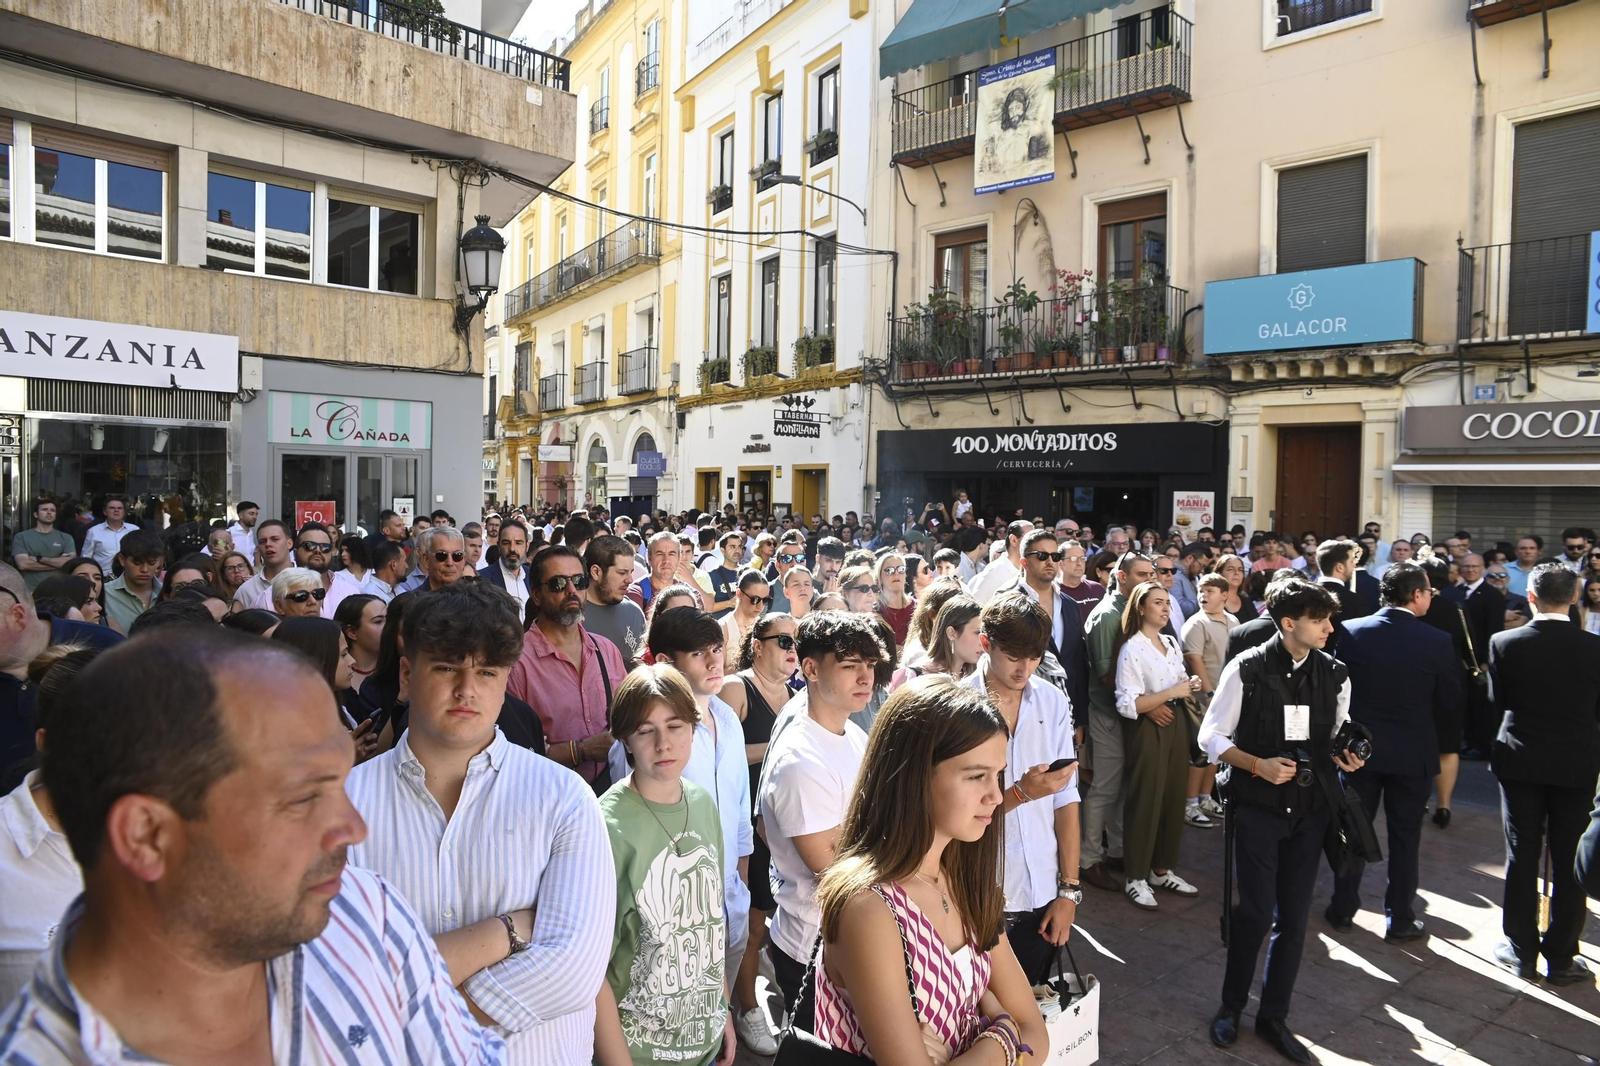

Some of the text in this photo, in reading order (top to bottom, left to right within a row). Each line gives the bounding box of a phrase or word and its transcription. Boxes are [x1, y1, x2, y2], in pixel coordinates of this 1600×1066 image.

[998, 64, 1016, 74] Cristo
[1016, 60, 1023, 68] de
[1024, 58, 1032, 66] las
[1032, 53, 1051, 64] Aguas
[1295, 290, 1307, 304] G
[1258, 317, 1347, 339] GALACOR
[1306, 387, 1313, 396] 3
[783, 411, 813, 420] TABERNA
[290, 427, 312, 438] LA
[775, 423, 819, 436] MONTILLANA
[952, 429, 1117, 454] 100 MONTADITOS
[1003, 459, 1062, 469] CERVECERÍA
[1176, 497, 1210, 508] MANÍA
[676, 1019, 706, 1048] THE
[1065, 1028, 1093, 1054] SILBON
